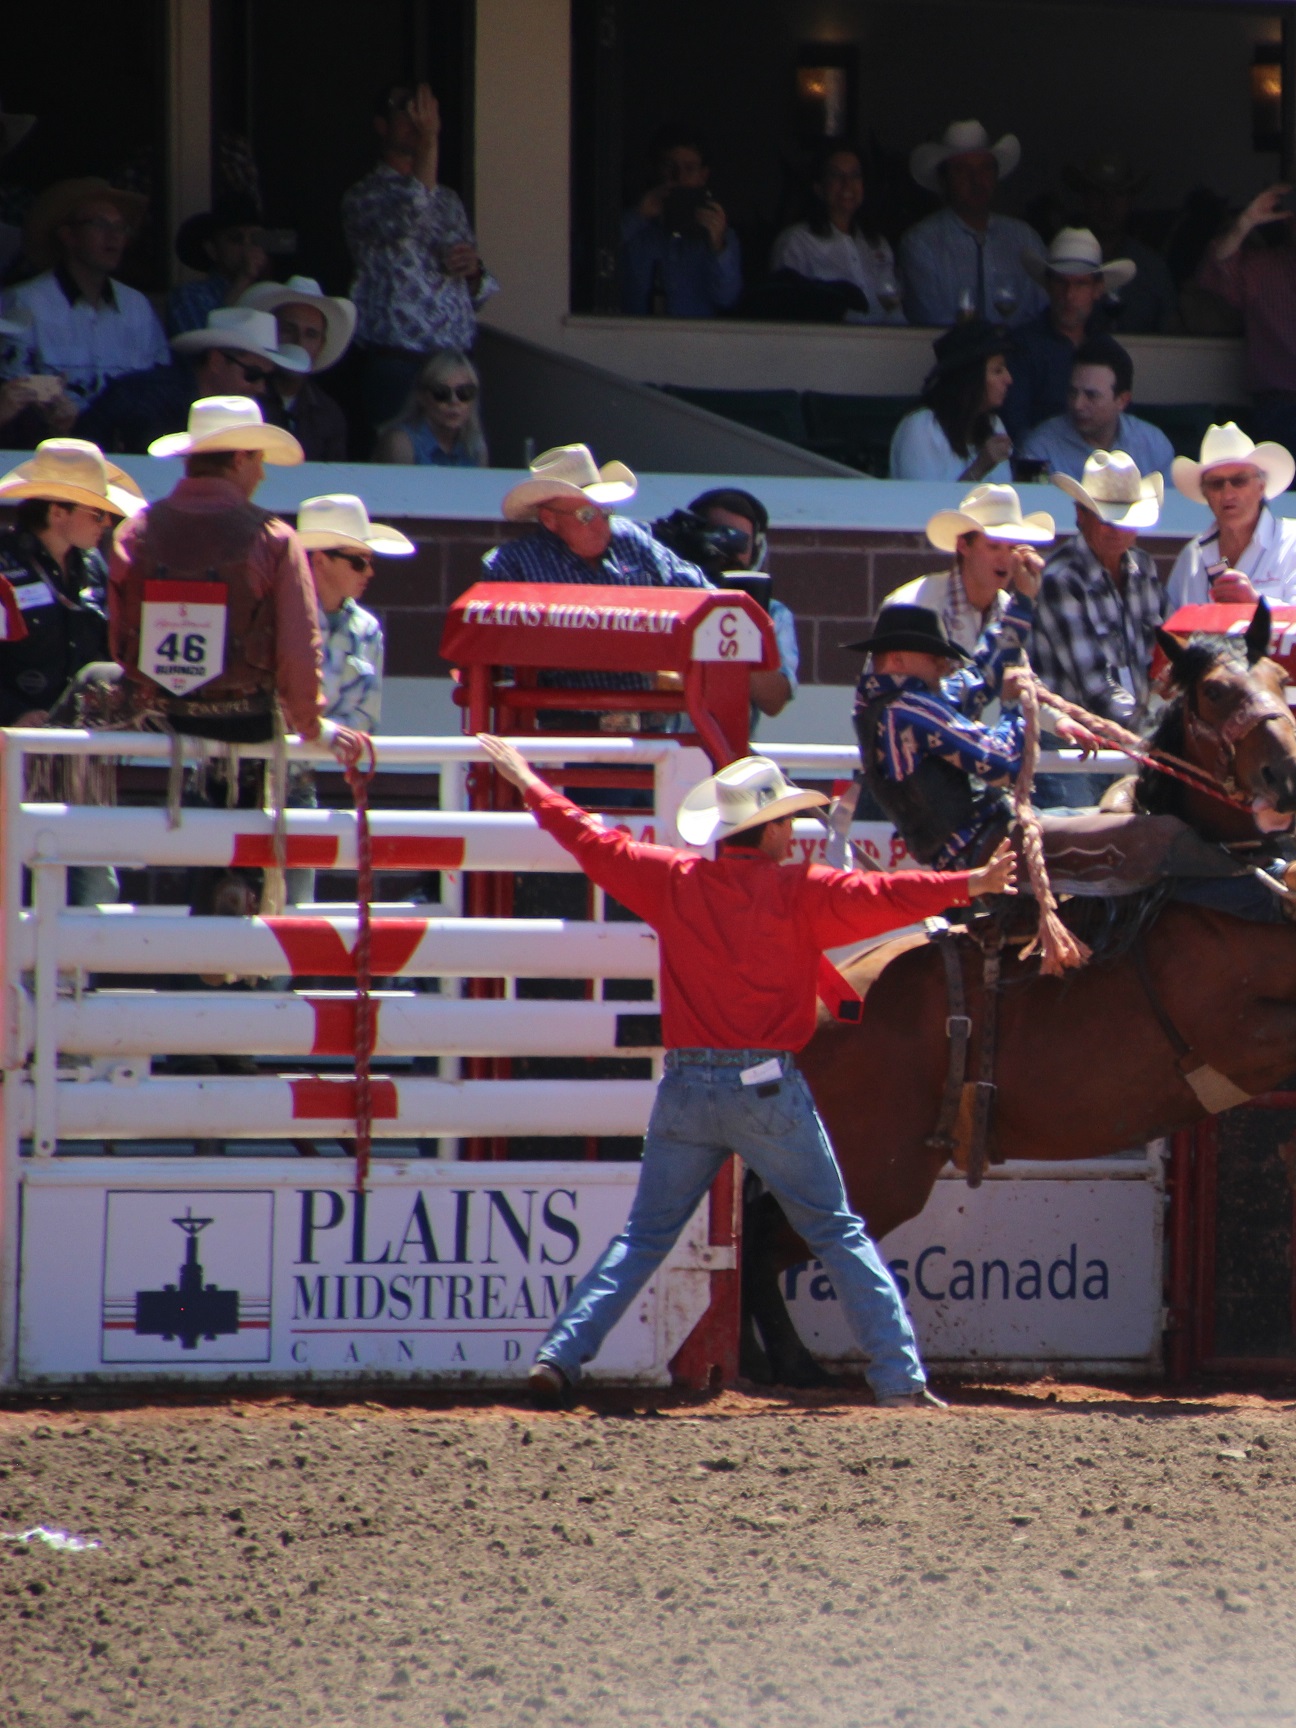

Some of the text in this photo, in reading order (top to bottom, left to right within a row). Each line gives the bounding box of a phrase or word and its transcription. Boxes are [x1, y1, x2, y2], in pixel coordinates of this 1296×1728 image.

[462, 599, 682, 635] PLAINS MIDSTREAM
[156, 632, 207, 664] 46
[293, 1188, 580, 1265] PLAINS
[291, 1275, 577, 1320] MIDSTREAM
[291, 1339, 521, 1364] CANAD
